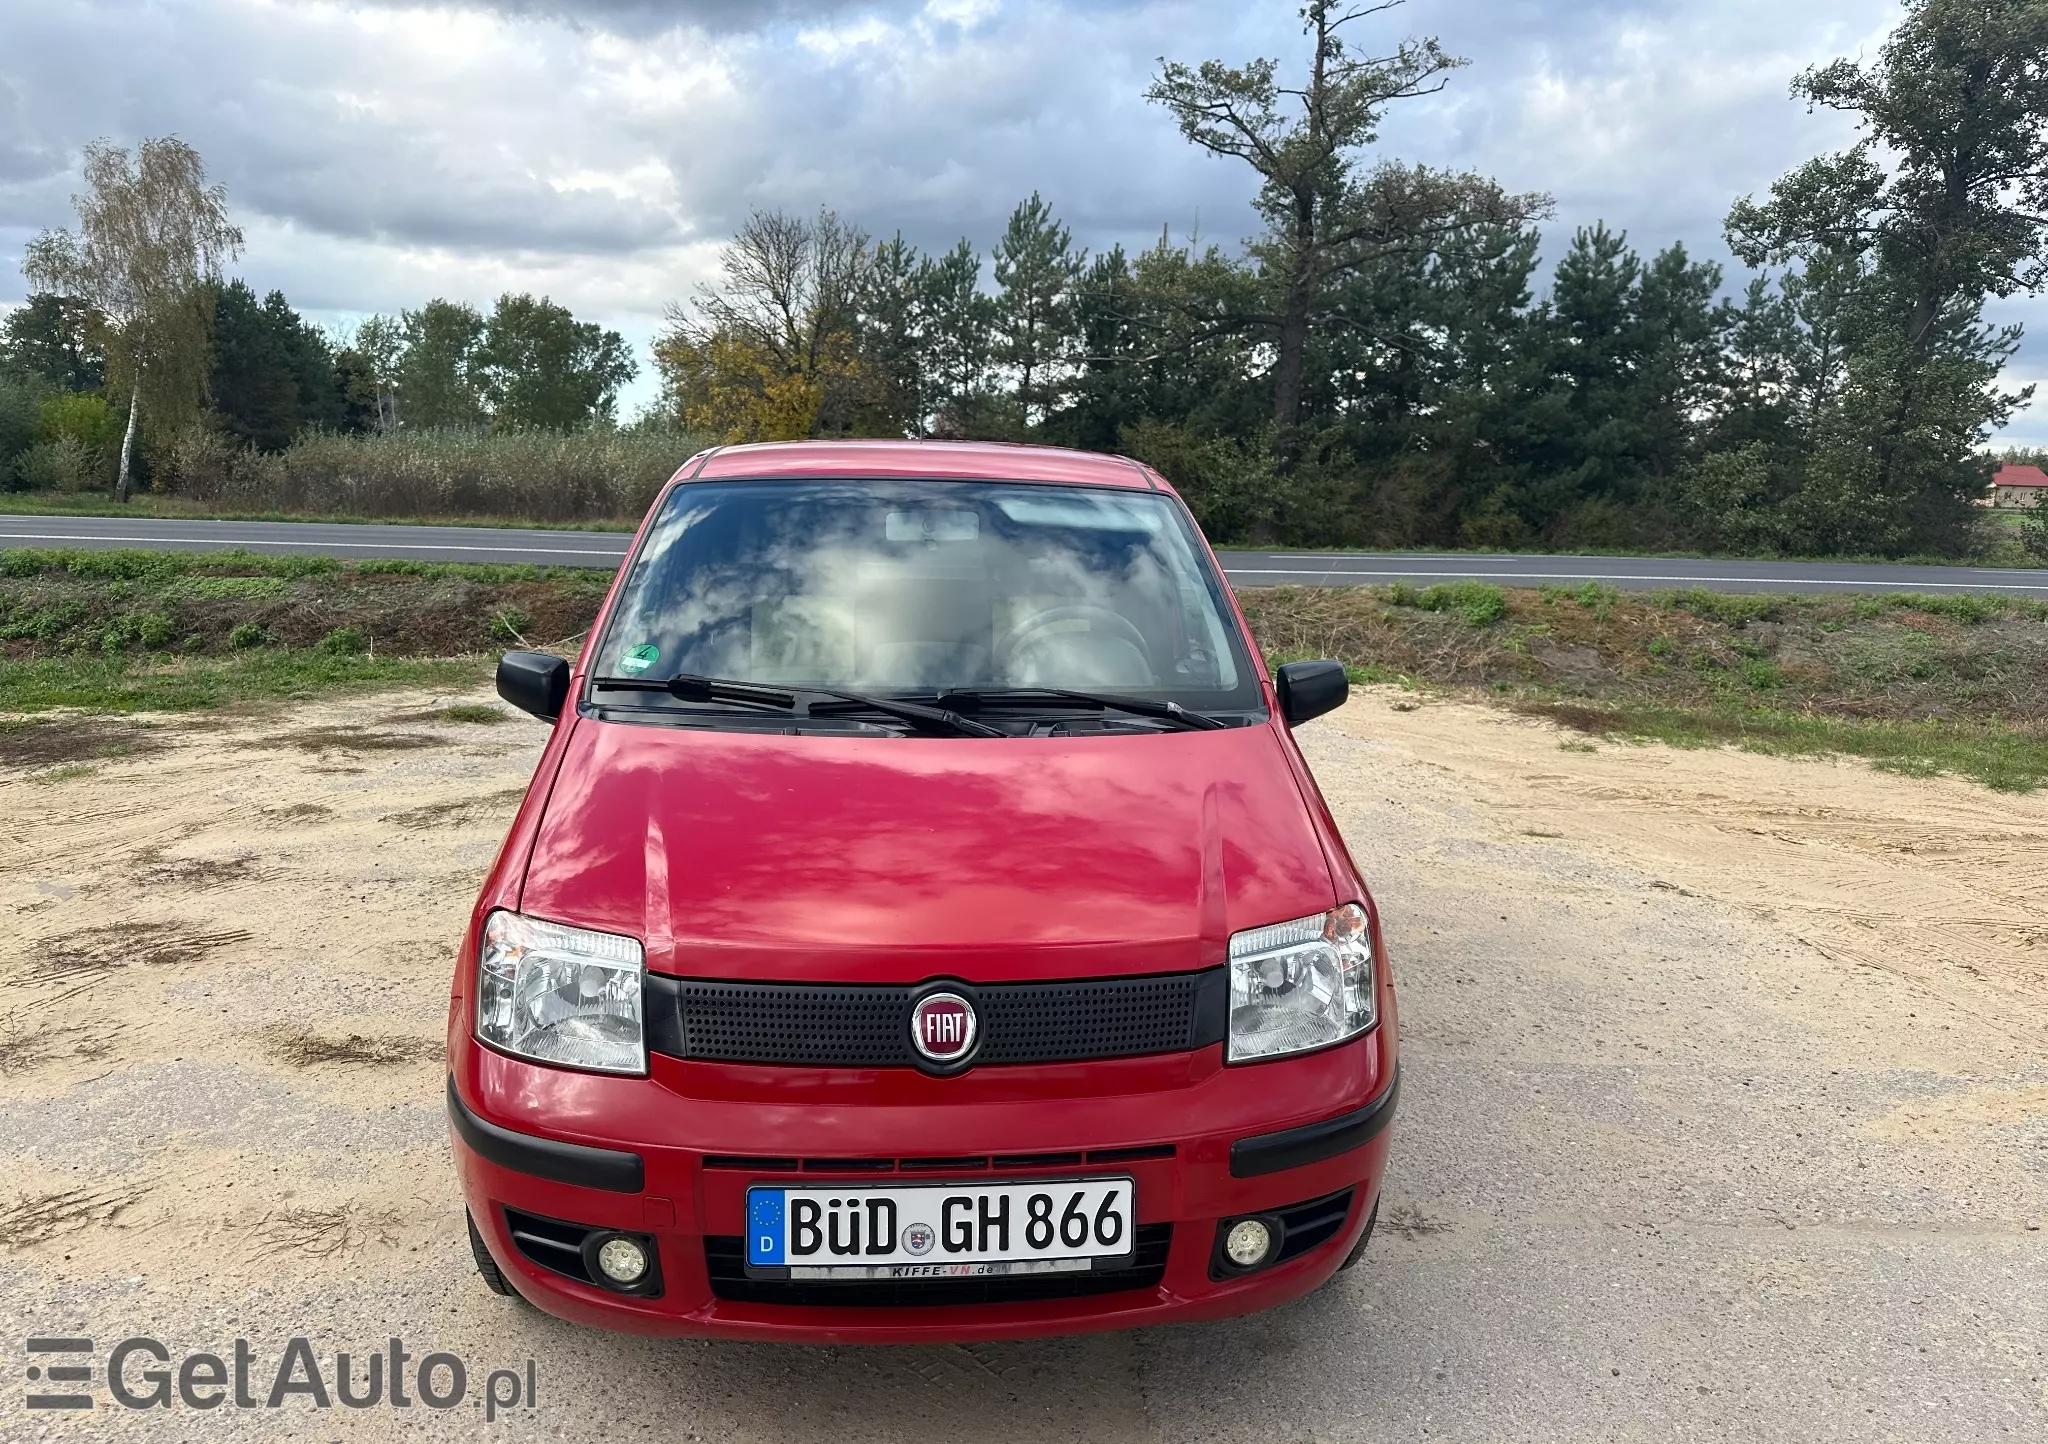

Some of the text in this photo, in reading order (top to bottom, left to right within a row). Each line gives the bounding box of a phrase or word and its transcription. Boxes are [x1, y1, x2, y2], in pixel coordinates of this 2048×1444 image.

[637, 646, 651, 659] 4
[926, 1012, 964, 1043] FIAT
[941, 1194, 1010, 1253] GH
[1025, 1190, 1123, 1250] 866
[760, 1236, 774, 1252] D
[892, 1263, 994, 1277] KIFFE-VN.de
